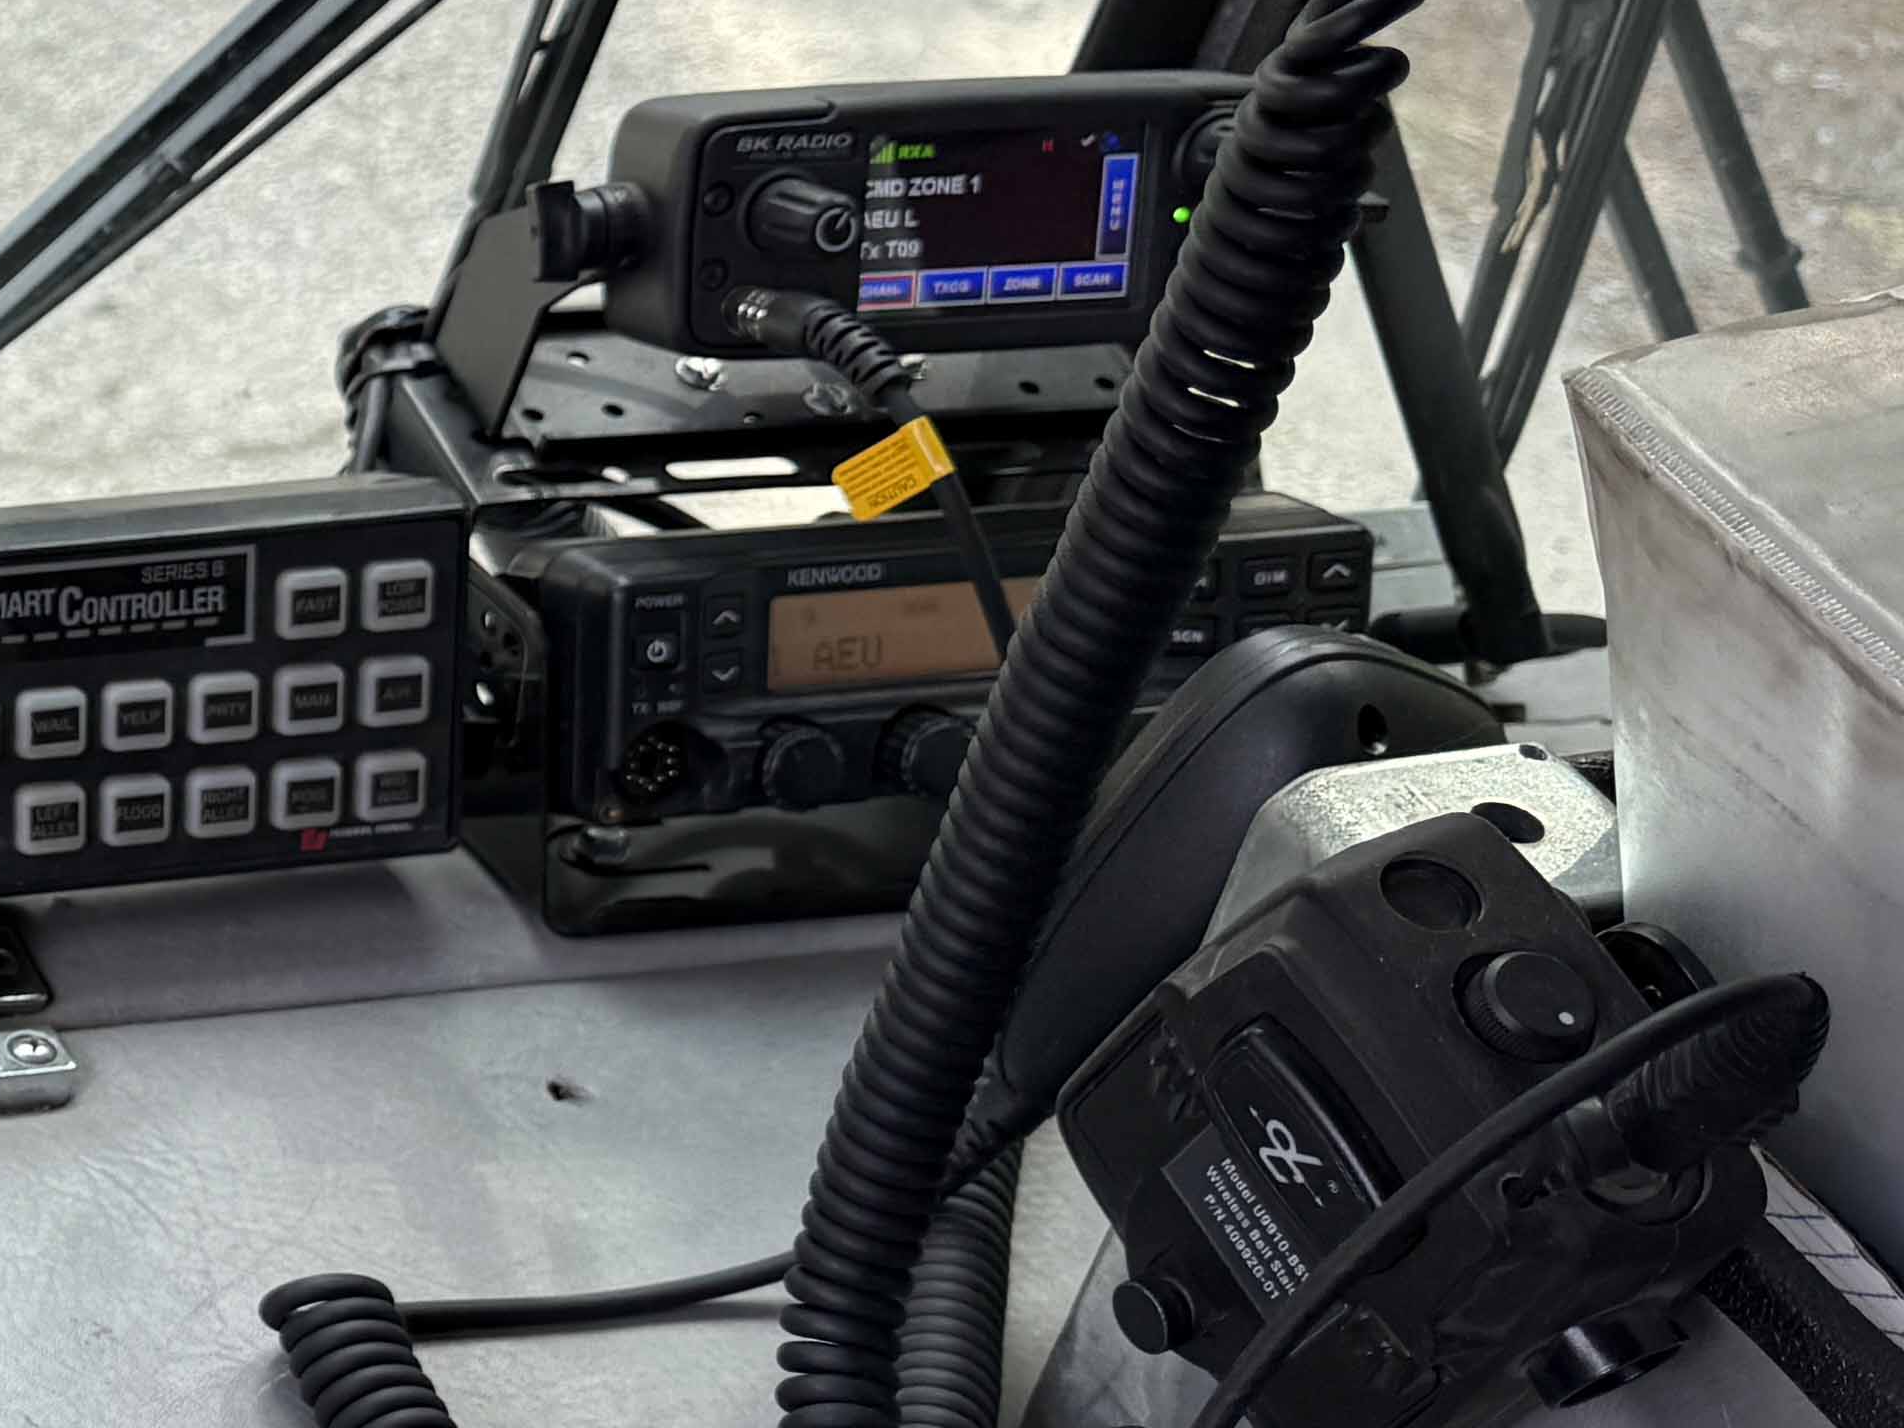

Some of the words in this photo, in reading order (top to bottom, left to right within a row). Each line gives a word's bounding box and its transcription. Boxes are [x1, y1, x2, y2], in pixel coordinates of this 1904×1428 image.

[776, 133, 853, 151] RADIO
[908, 175, 967, 197] ZONE
[970, 174, 982, 194] 1
[787, 563, 882, 587] KENWOOD
[1254, 570, 1287, 586] DIM
[57, 585, 226, 627] CONTROLLER
[813, 635, 883, 671] AEU
[1220, 1157, 1257, 1204] Model
[1206, 1165, 1251, 1228] Wireless
